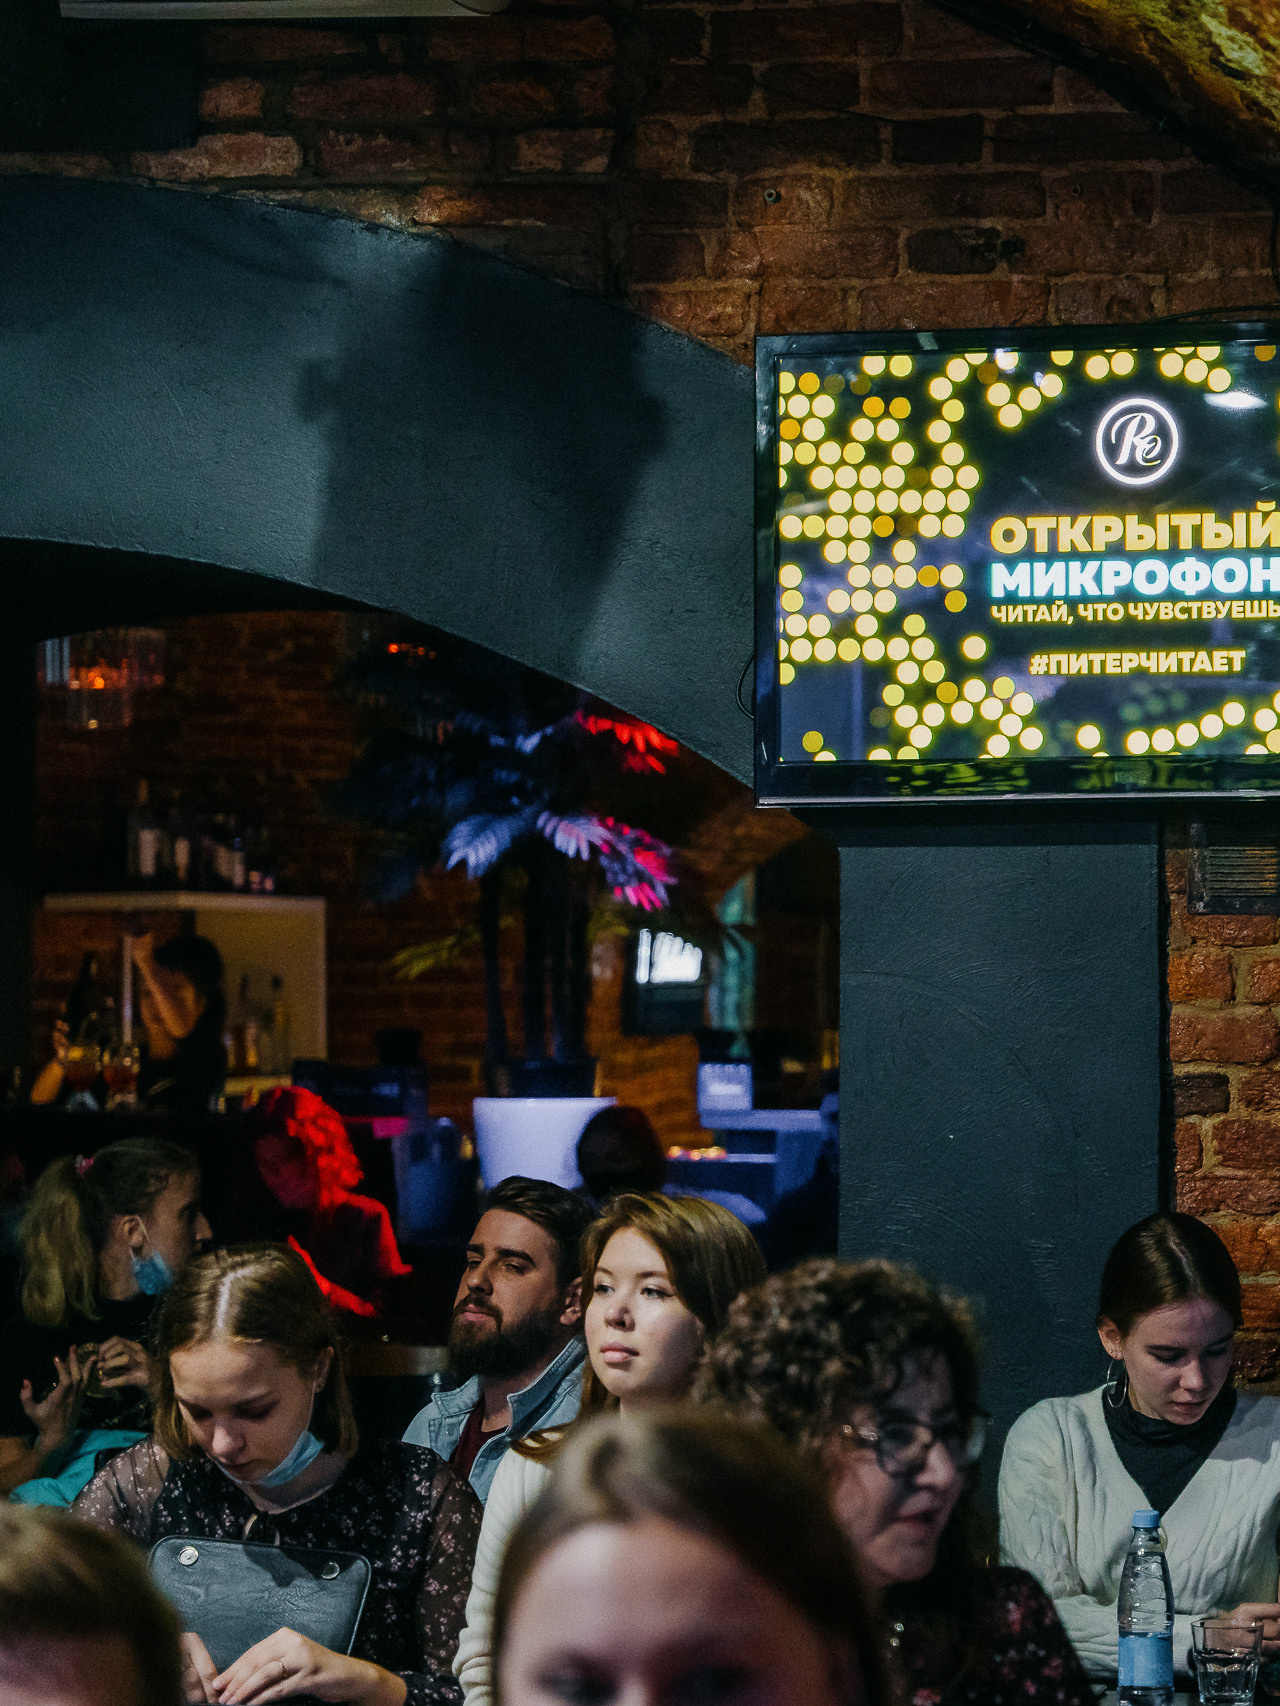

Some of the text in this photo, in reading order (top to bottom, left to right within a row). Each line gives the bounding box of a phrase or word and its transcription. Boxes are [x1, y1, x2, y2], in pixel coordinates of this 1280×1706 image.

[991, 600, 1074, 625] ЧИТАЙ,
[1077, 602, 1125, 621] ЧТО
[1029, 650, 1246, 675] #ПИТЕРЧИТАЕТ
